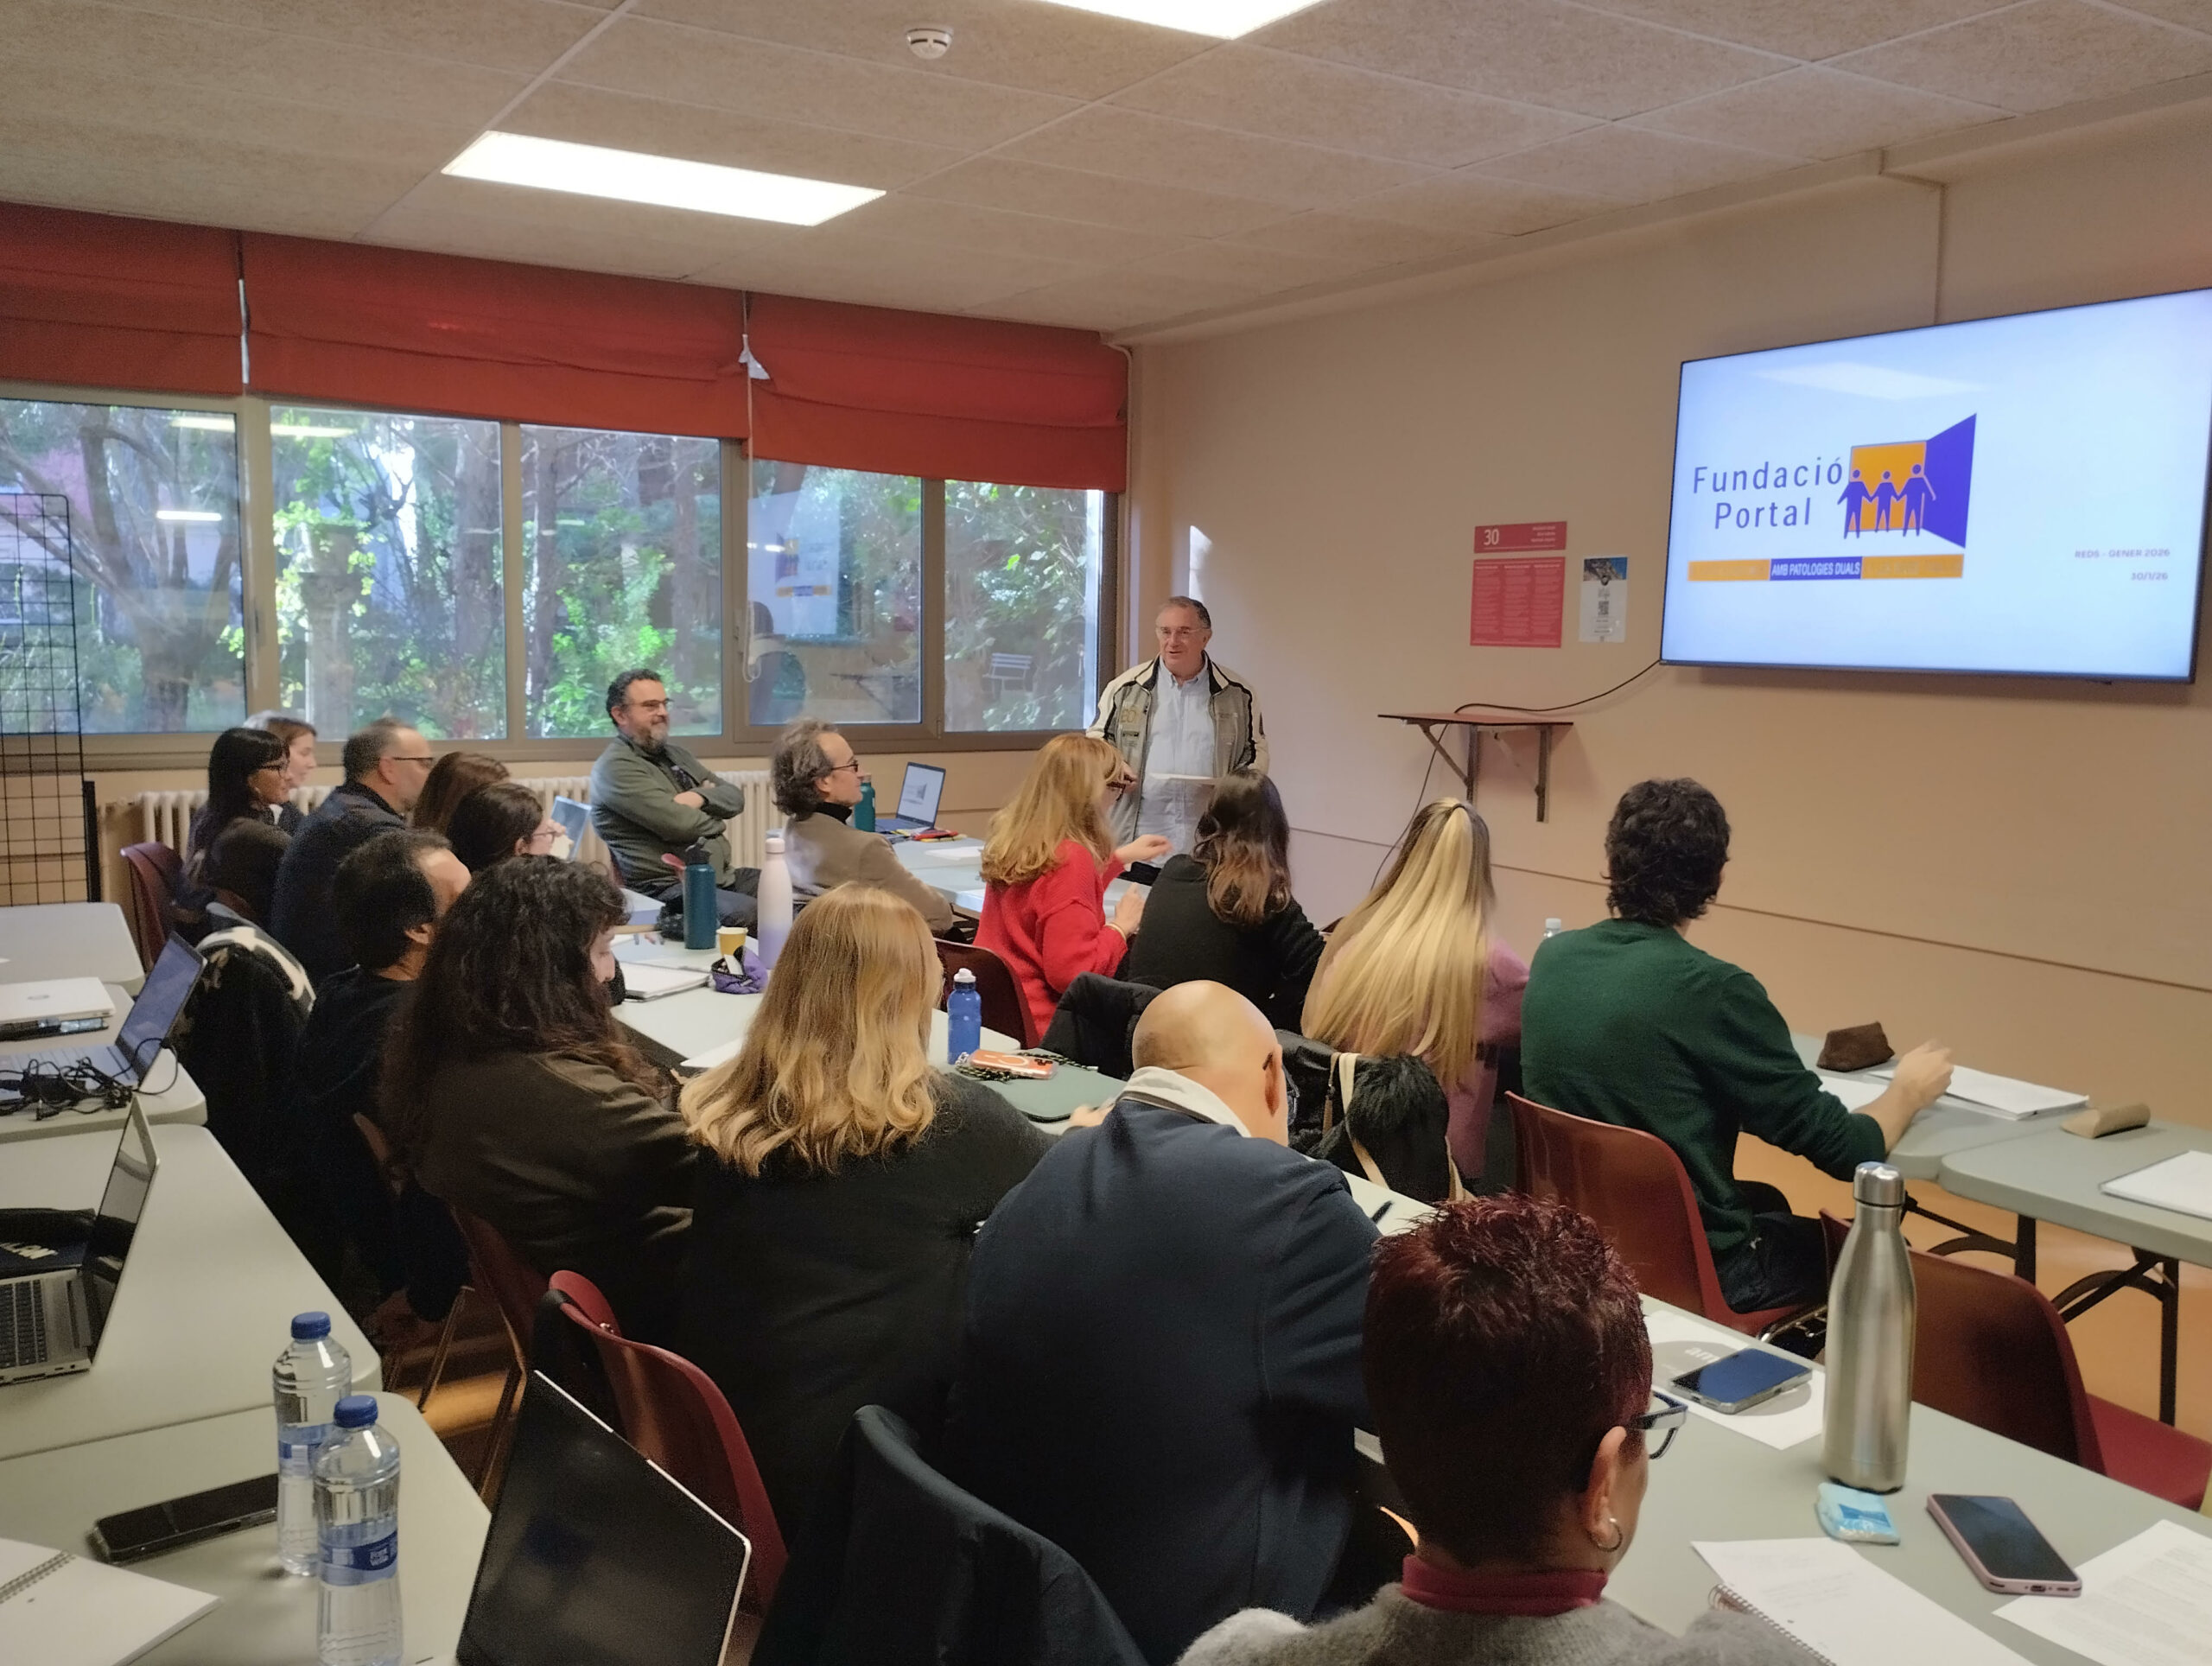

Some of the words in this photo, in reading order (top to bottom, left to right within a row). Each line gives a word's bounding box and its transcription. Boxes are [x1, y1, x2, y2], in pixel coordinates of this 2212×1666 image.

[1694, 457, 1843, 493] Fundació
[1715, 498, 1811, 529] Portal
[1484, 529, 1500, 546] 30
[2145, 548, 2171, 558] 2026
[1771, 563, 1789, 576] AMB
[1789, 562, 1834, 575] PATOLOGIES
[1835, 561, 1860, 575] DUALS
